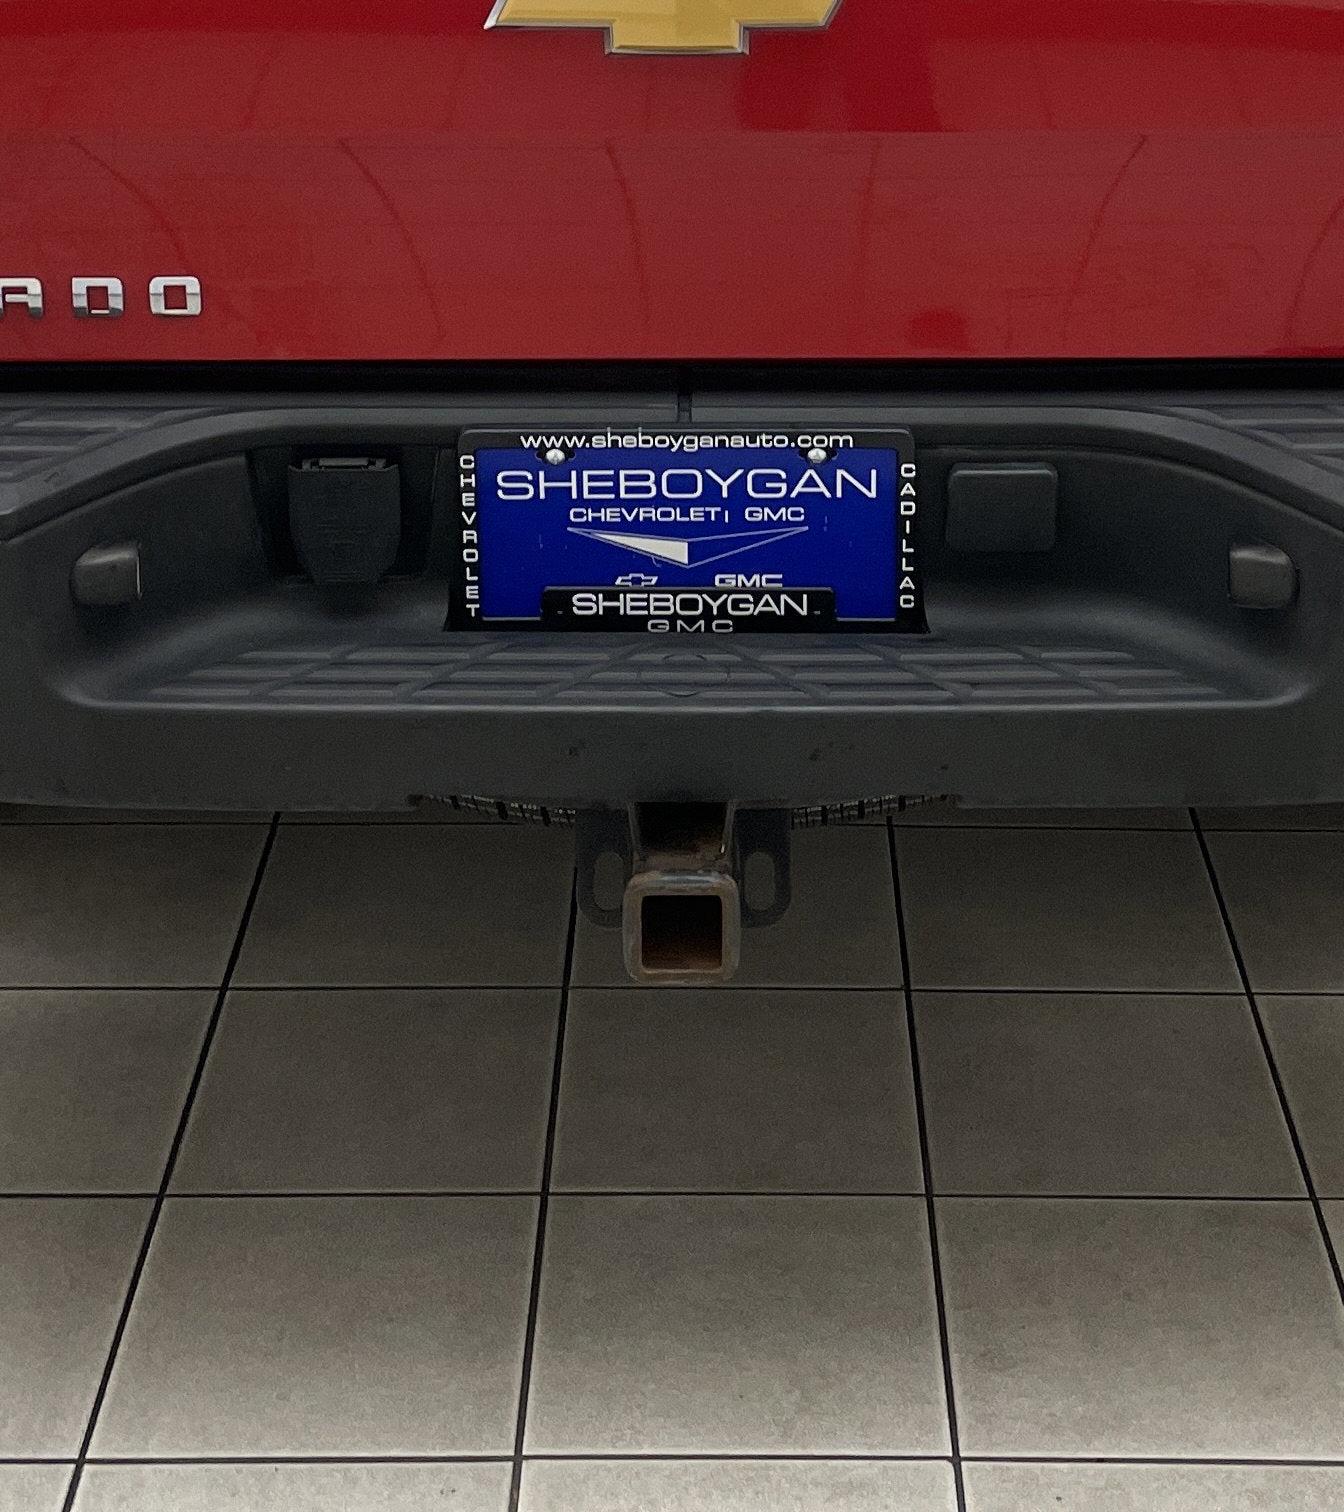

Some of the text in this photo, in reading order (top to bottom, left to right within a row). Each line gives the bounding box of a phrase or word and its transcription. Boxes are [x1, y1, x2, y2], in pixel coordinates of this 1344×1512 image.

[519, 427, 854, 453] www.sheboyganauto.com
[496, 468, 877, 500] SHEBOYGAN
[569, 506, 805, 523] CHEVROLET GMC
[459, 454, 480, 617] CHEVROLET
[899, 463, 916, 608] CADILLAC
[714, 573, 783, 588] GMC
[572, 593, 808, 616] SHEBOYGAN
[647, 619, 734, 633] GMC
